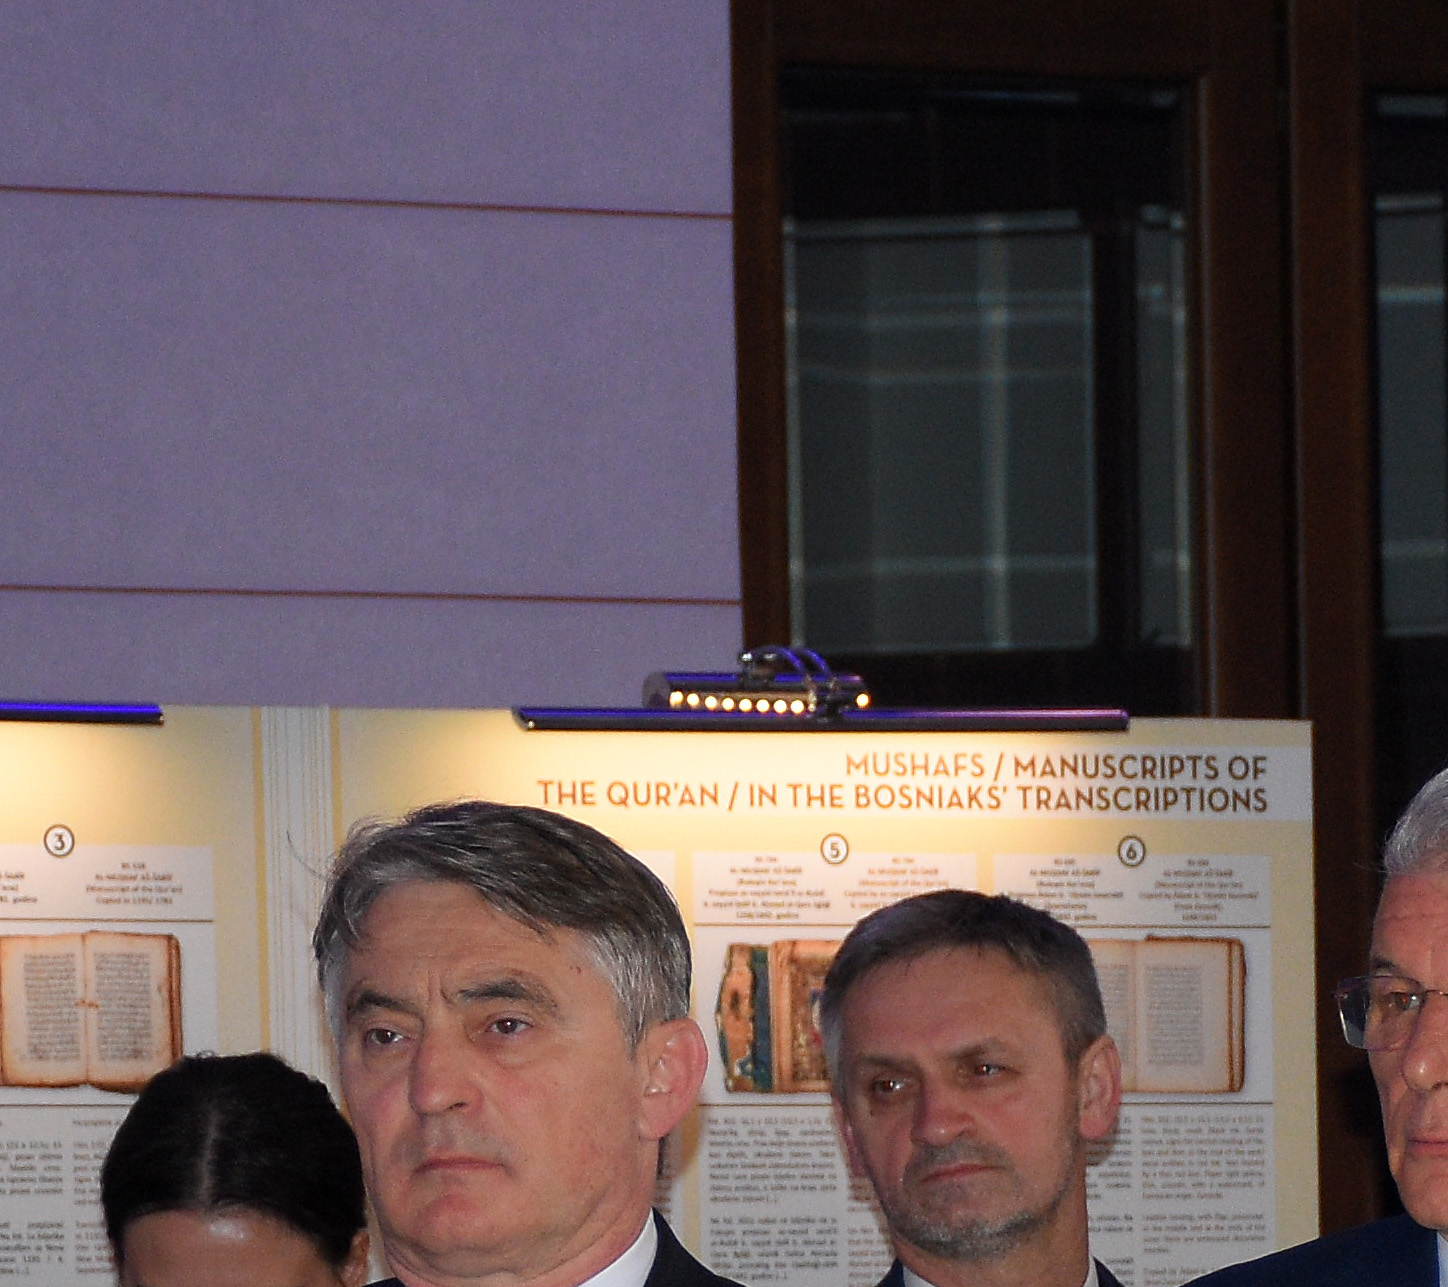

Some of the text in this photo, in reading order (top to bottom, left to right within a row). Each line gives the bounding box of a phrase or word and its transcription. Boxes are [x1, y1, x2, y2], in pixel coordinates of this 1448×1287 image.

[846, 751, 1268, 782] MUSHAFS / MANUSCRIPTS OF
[537, 780, 596, 806] THE
[727, 782, 740, 812] /
[750, 784, 778, 808] IN
[787, 784, 845, 809] THE
[1018, 786, 1269, 812] TRANSCRIPTIONS
[55, 833, 65, 851] 3
[830, 842, 840, 859] 5
[1126, 844, 1137, 860] 6
